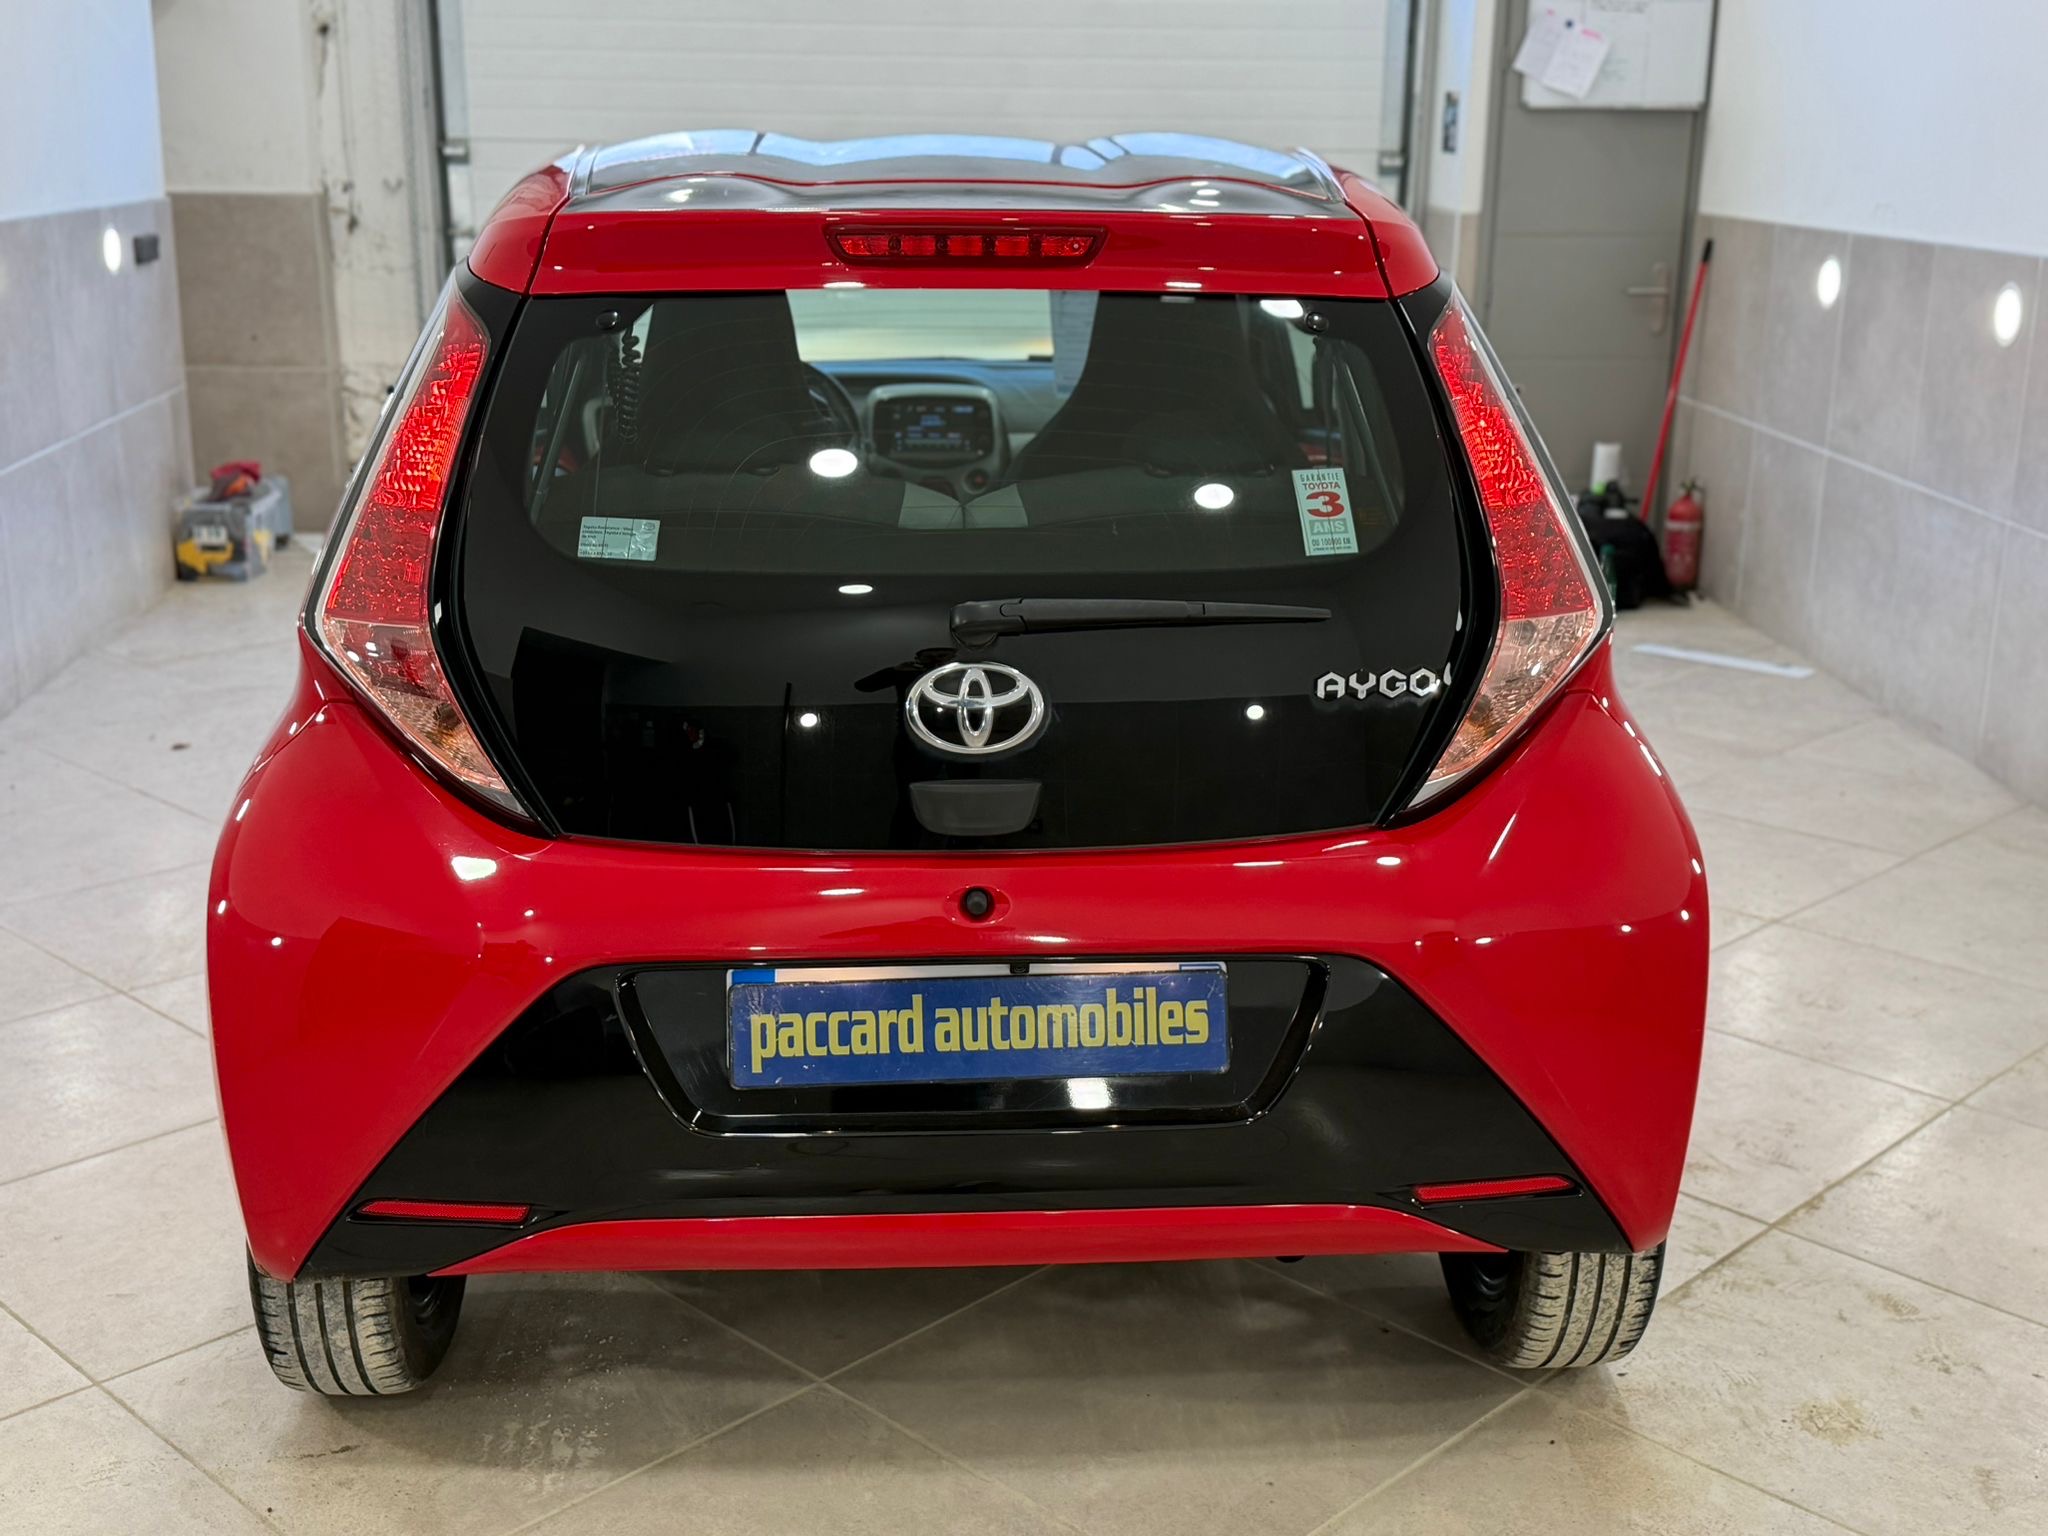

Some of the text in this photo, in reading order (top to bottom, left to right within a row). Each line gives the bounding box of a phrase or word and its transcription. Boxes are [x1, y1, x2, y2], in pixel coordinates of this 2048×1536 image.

[1302, 481, 1341, 490] TOYOTA
[1306, 491, 1345, 518] 3
[1312, 520, 1345, 533] ANS
[1316, 667, 1437, 699] AYGO
[750, 986, 1210, 1074] paccard automobiles
